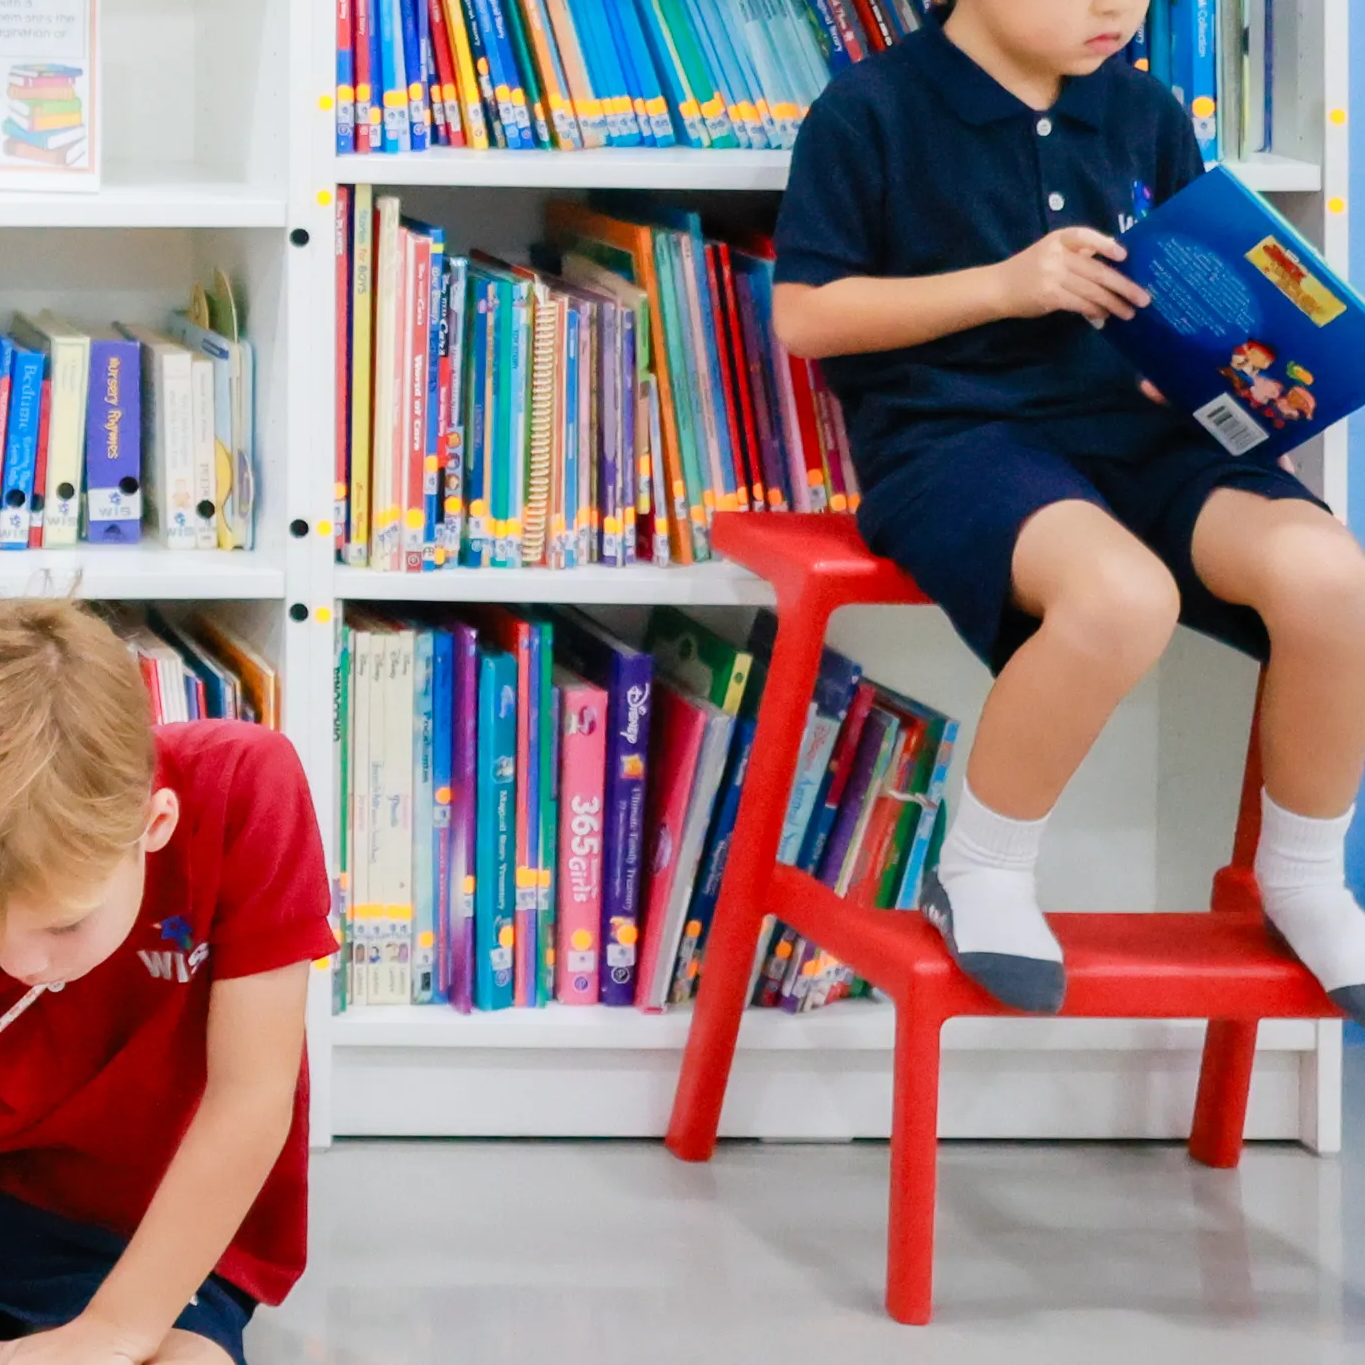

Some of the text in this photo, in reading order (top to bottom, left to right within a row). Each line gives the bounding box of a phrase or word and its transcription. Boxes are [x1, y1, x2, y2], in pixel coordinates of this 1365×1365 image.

[1196, 9, 1208, 58] Collection
[102, 357, 123, 459] Nursery Rhymes
[567, 794, 599, 903] 365 Girls
